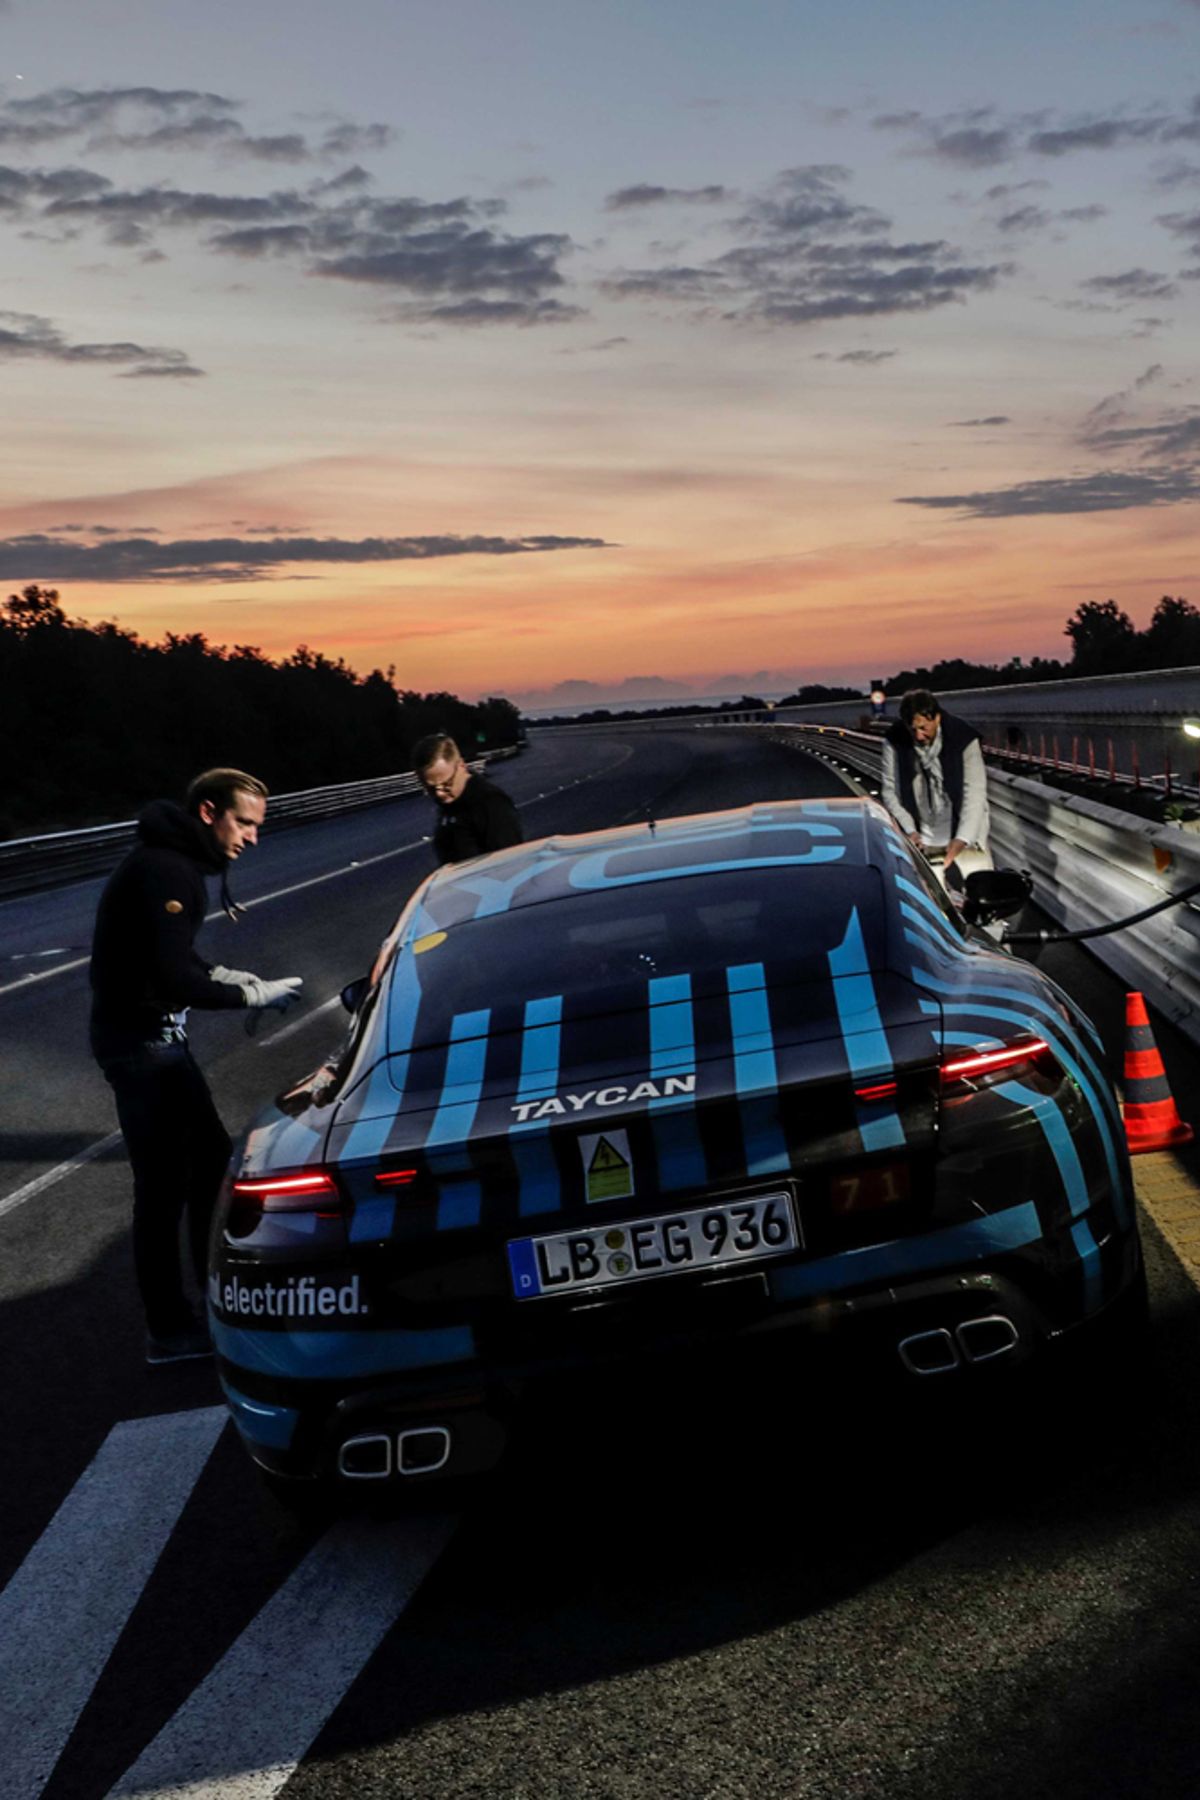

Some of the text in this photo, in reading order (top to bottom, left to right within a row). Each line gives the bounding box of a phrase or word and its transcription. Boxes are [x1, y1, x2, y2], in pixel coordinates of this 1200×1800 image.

[510, 1074, 697, 1122] TAYCAN
[519, 1204, 789, 1288] D LB EG 936
[223, 1273, 369, 1316] electrified.
